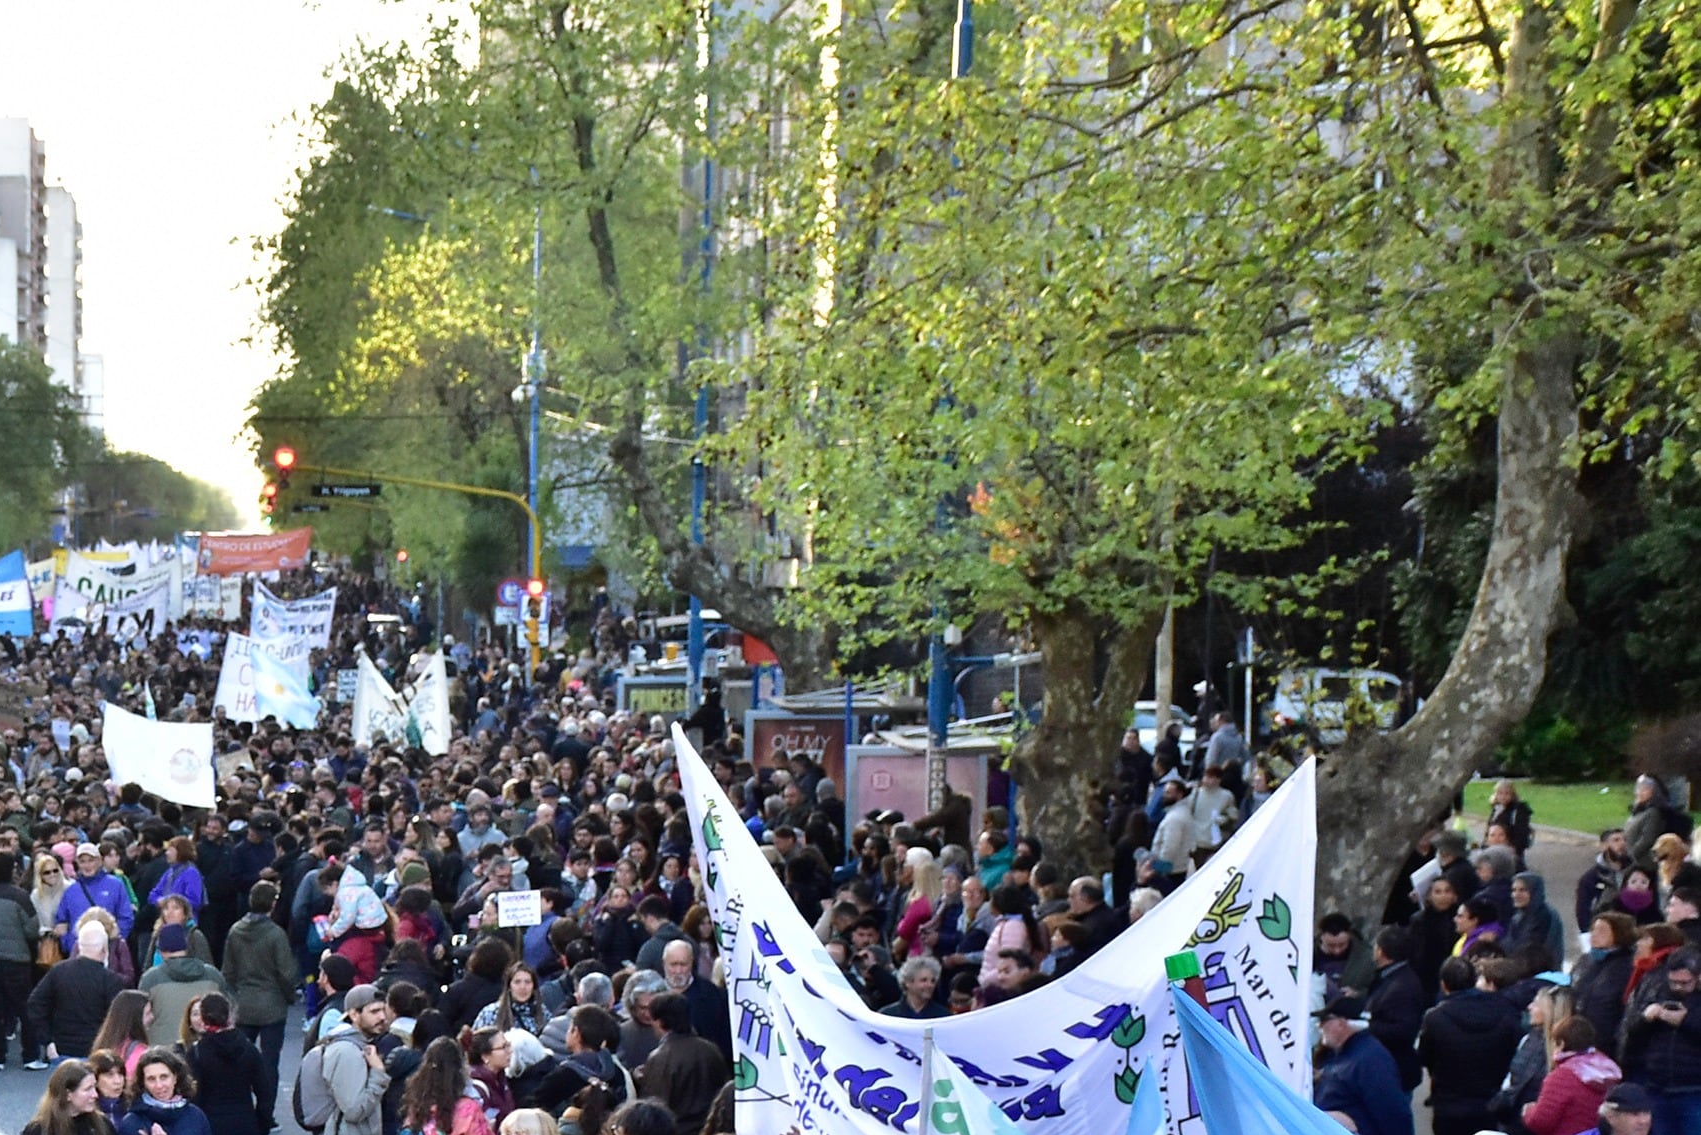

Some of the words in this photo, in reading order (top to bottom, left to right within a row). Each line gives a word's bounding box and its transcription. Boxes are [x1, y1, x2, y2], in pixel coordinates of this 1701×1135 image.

[771, 733, 800, 751] OH
[802, 734, 833, 751] MY
[1233, 942, 1273, 1001] Mar
